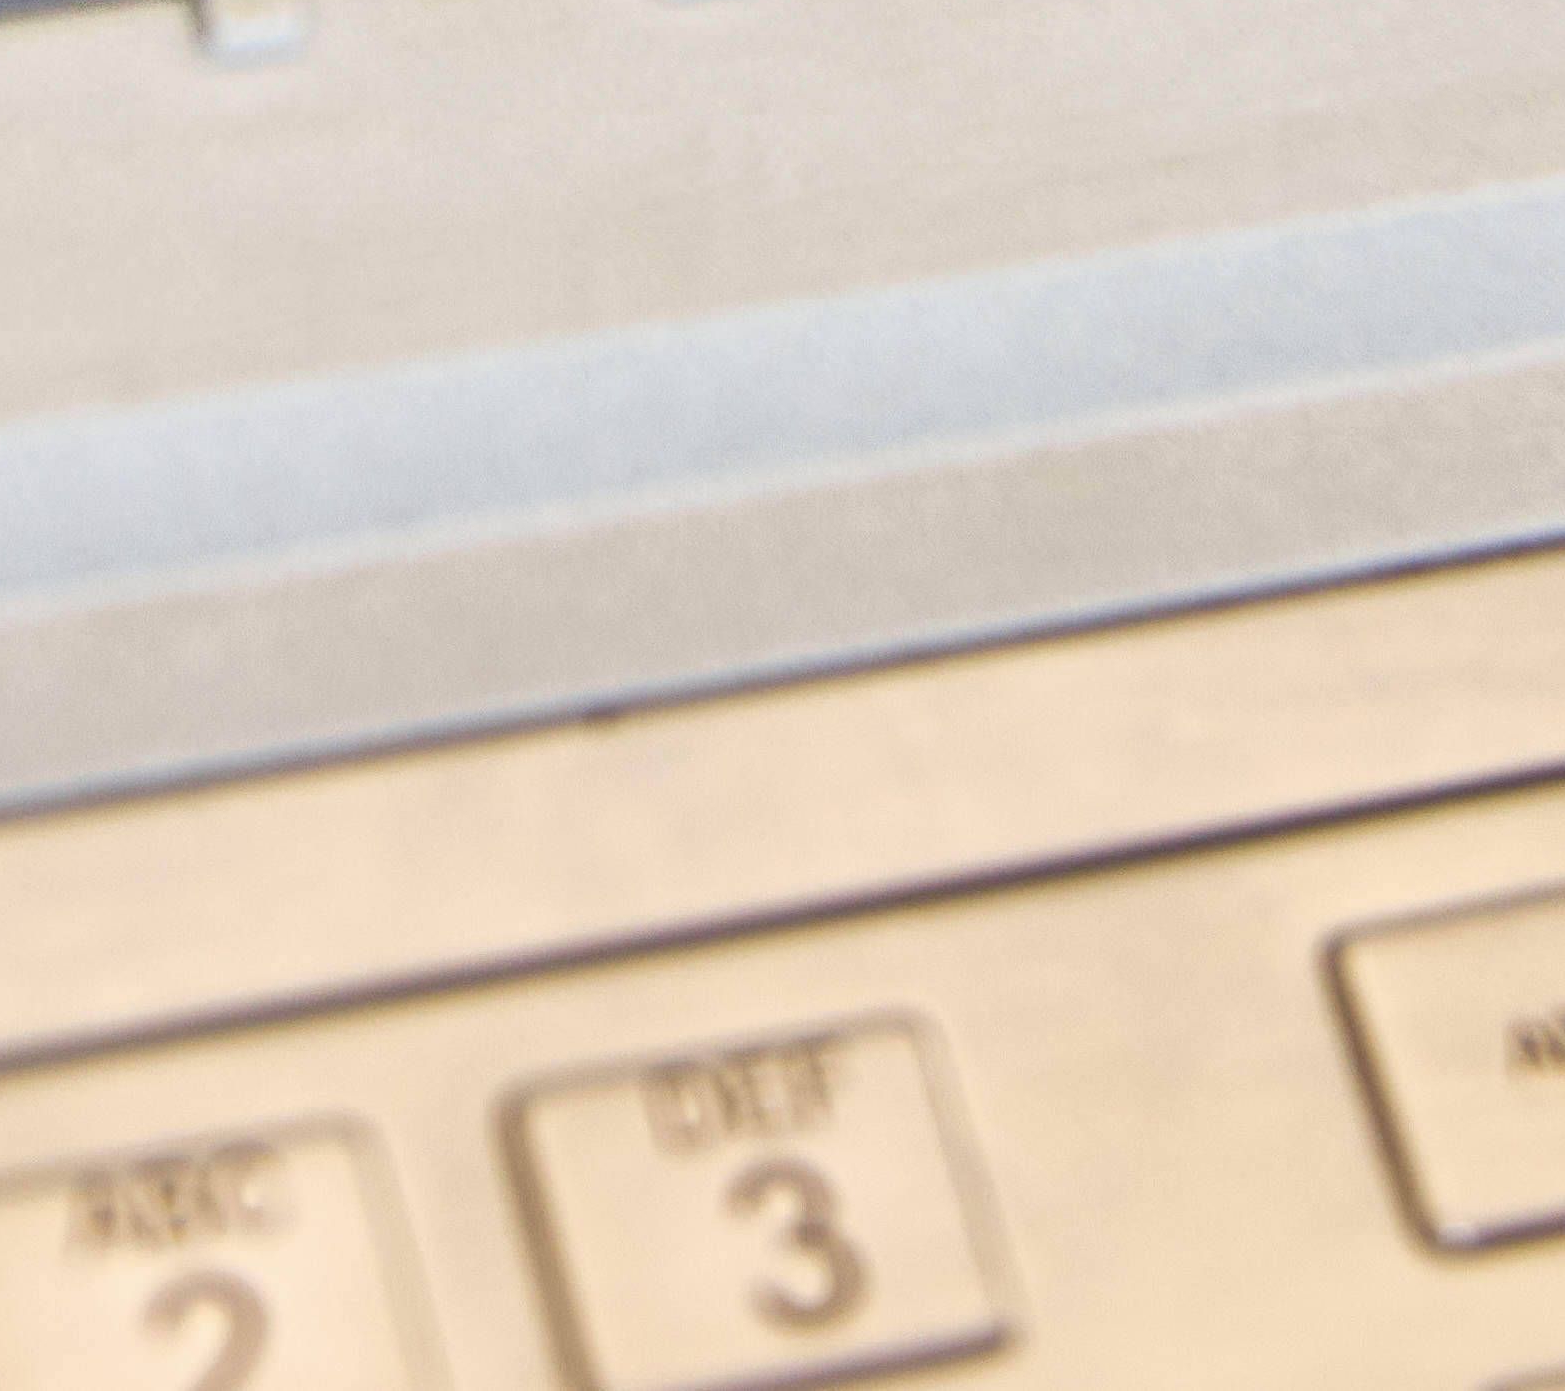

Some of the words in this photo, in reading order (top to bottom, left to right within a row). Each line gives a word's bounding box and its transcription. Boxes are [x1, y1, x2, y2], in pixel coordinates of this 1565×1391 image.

[640, 1039, 835, 1156] DEF
[727, 1157, 871, 1335] 3
[139, 1267, 273, 1391] 2
